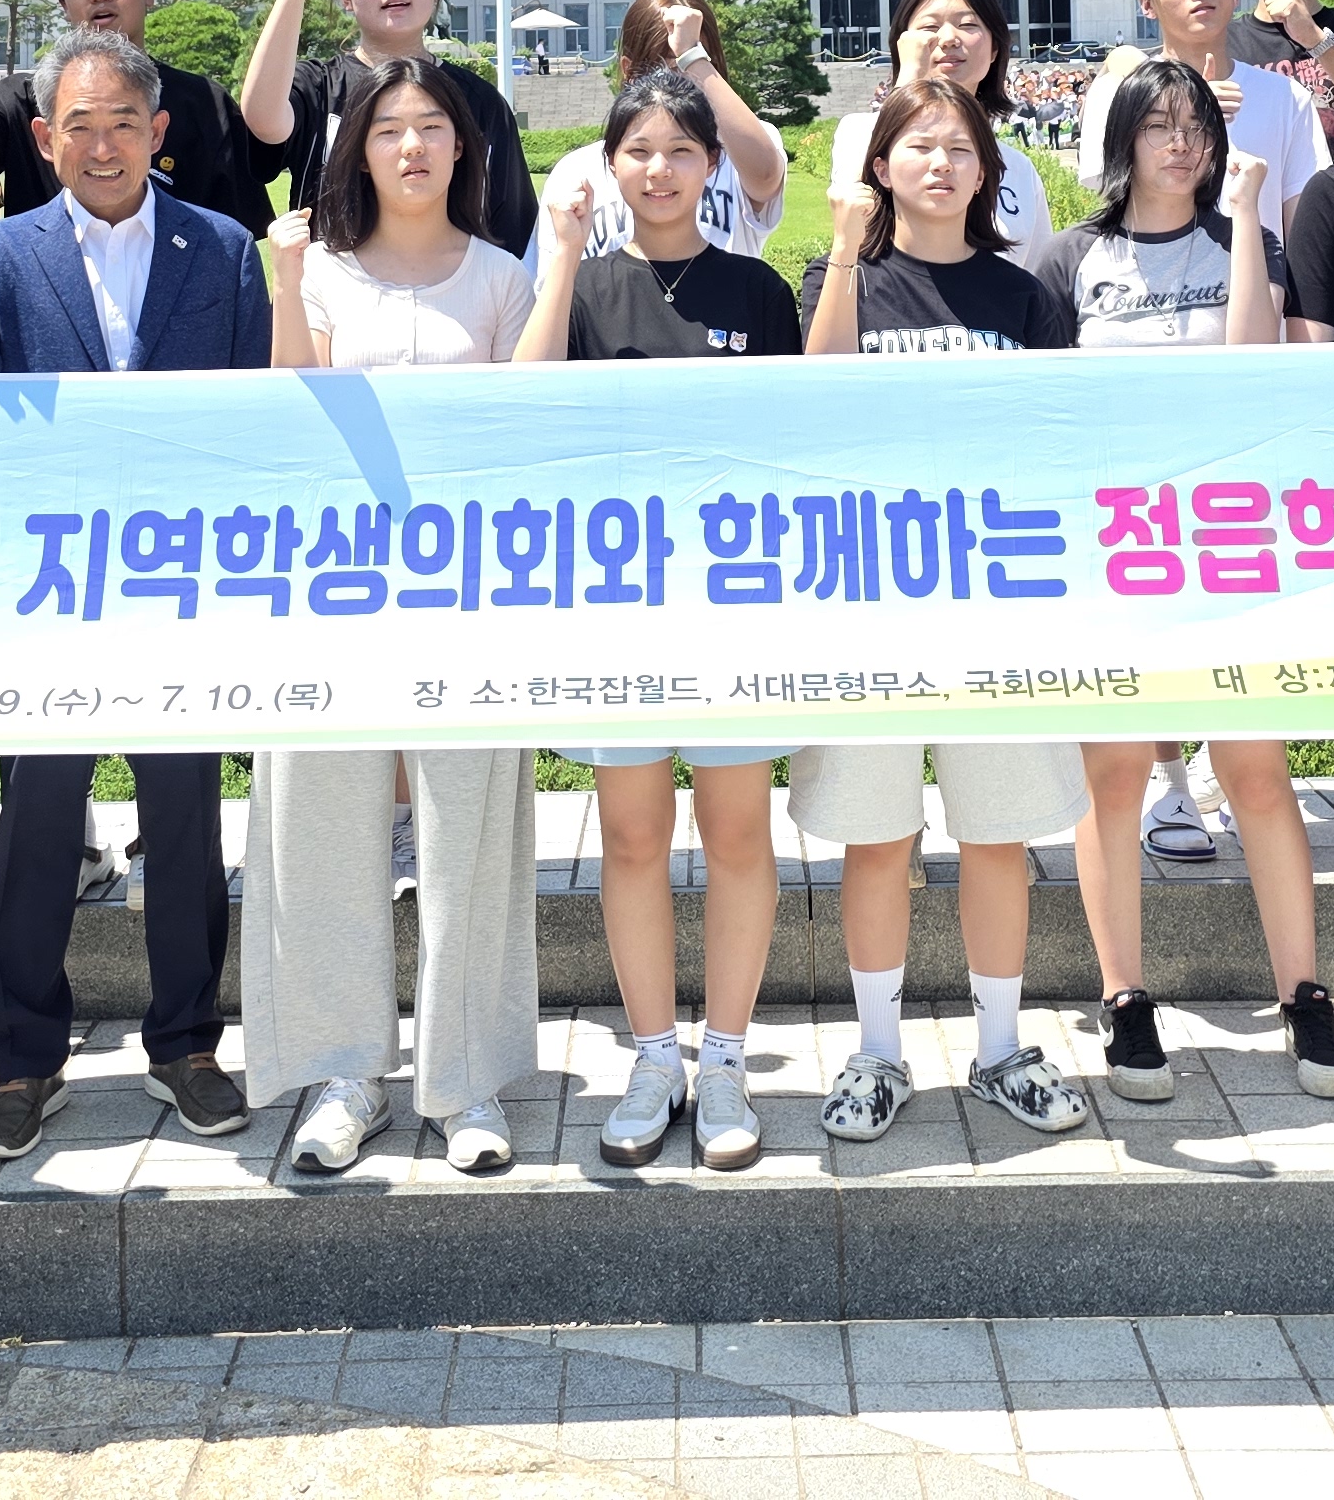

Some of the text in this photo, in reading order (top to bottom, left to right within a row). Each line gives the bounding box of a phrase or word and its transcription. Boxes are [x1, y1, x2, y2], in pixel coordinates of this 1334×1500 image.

[16, 495, 674, 622] 지역학생의회와
[698, 487, 1067, 605] 함께하는
[161, 684, 188, 714] 7.
[728, 669, 950, 704] 서대문형무소,
[965, 666, 1140, 699] 국회의사당
